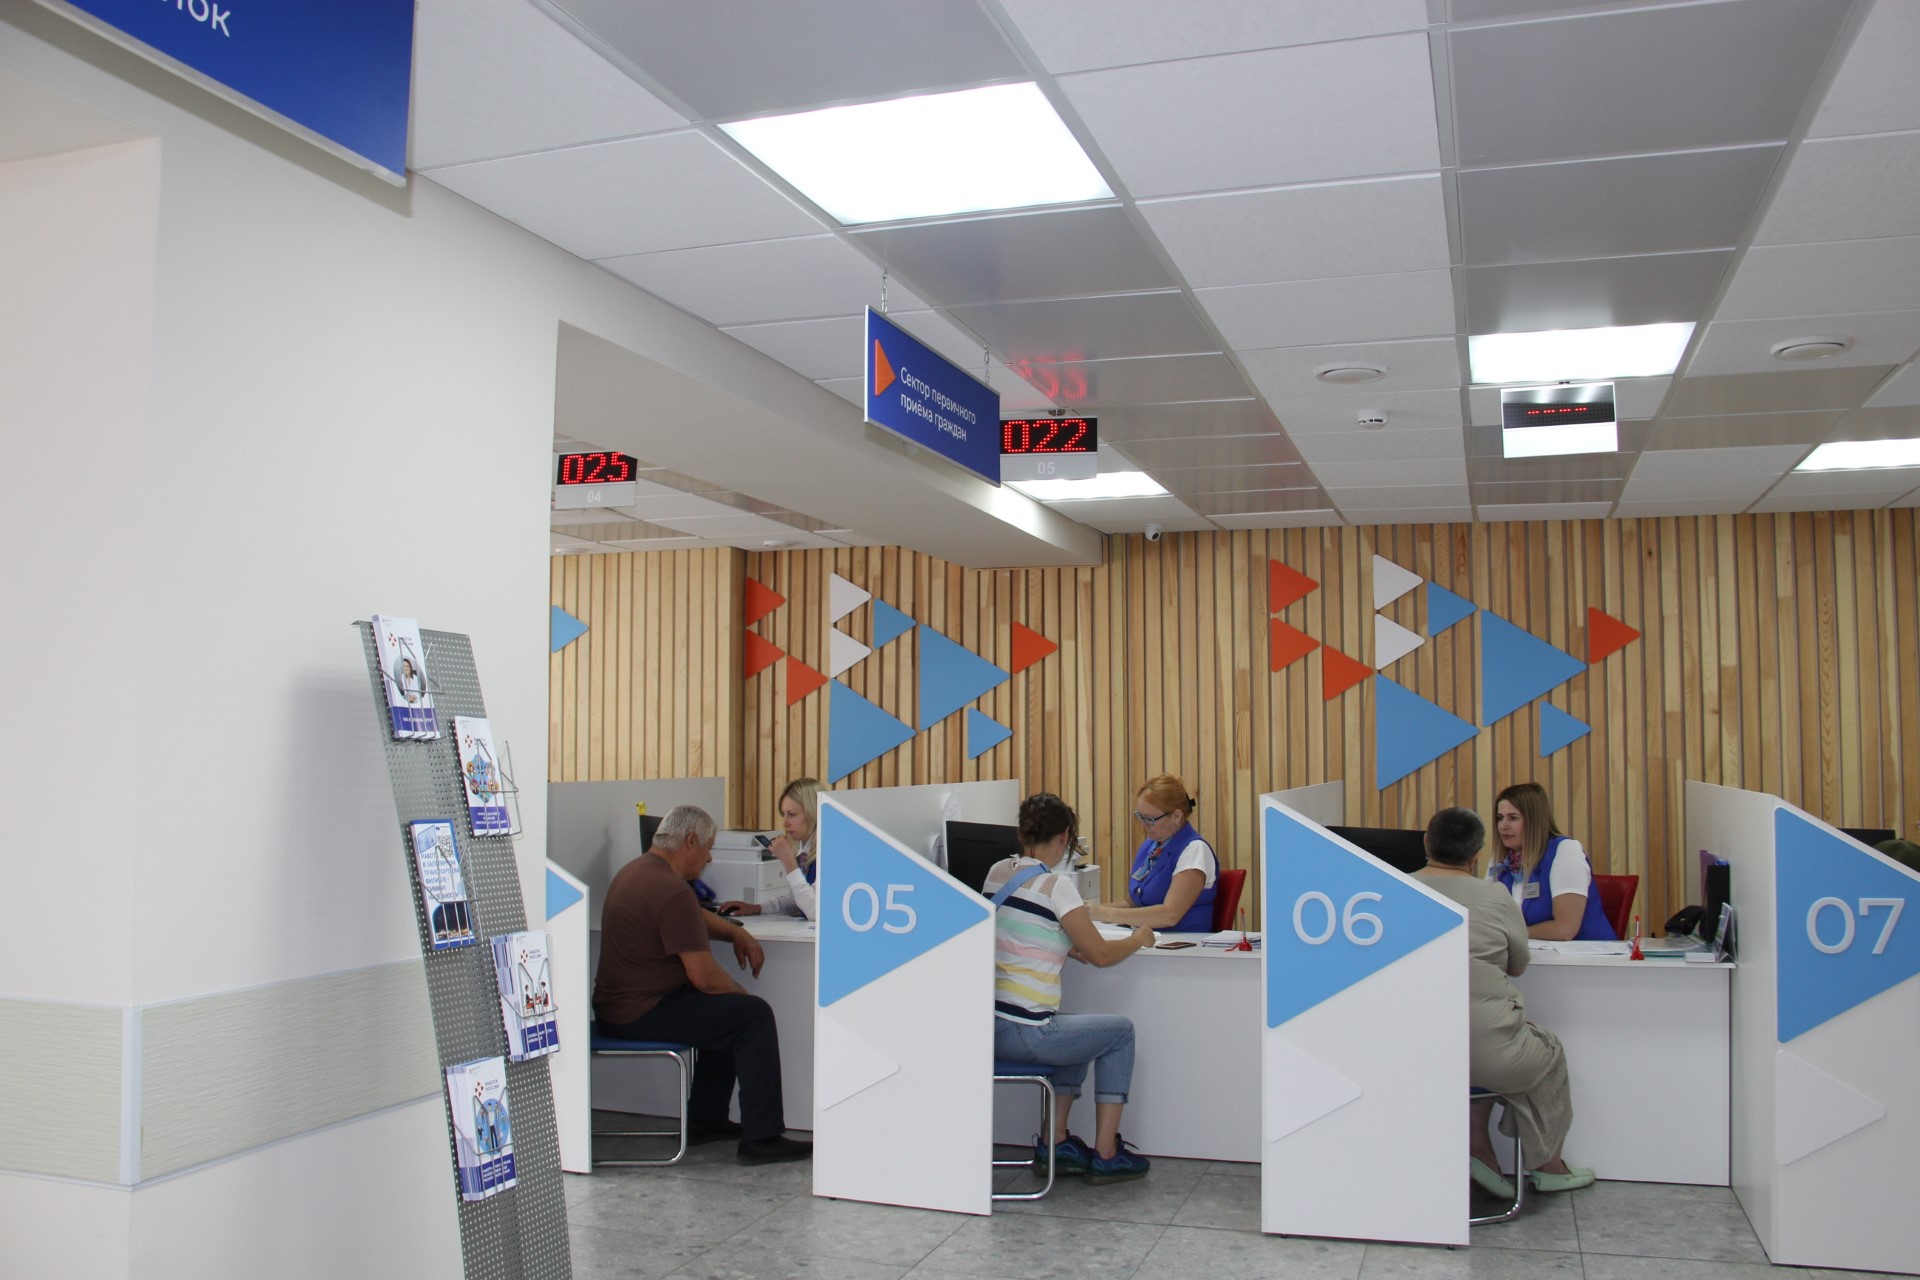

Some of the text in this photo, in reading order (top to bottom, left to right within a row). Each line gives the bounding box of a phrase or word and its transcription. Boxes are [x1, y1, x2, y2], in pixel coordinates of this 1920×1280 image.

[900, 366, 976, 425] Сектор первичного
[900, 393, 967, 442] приёма граждан
[1004, 419, 1087, 453] 022
[562, 452, 629, 484] 025
[1037, 461, 1056, 475] 05
[587, 491, 603, 503] 04
[842, 882, 917, 934] 05
[1292, 891, 1384, 946] 06
[1806, 896, 1905, 955] 07
